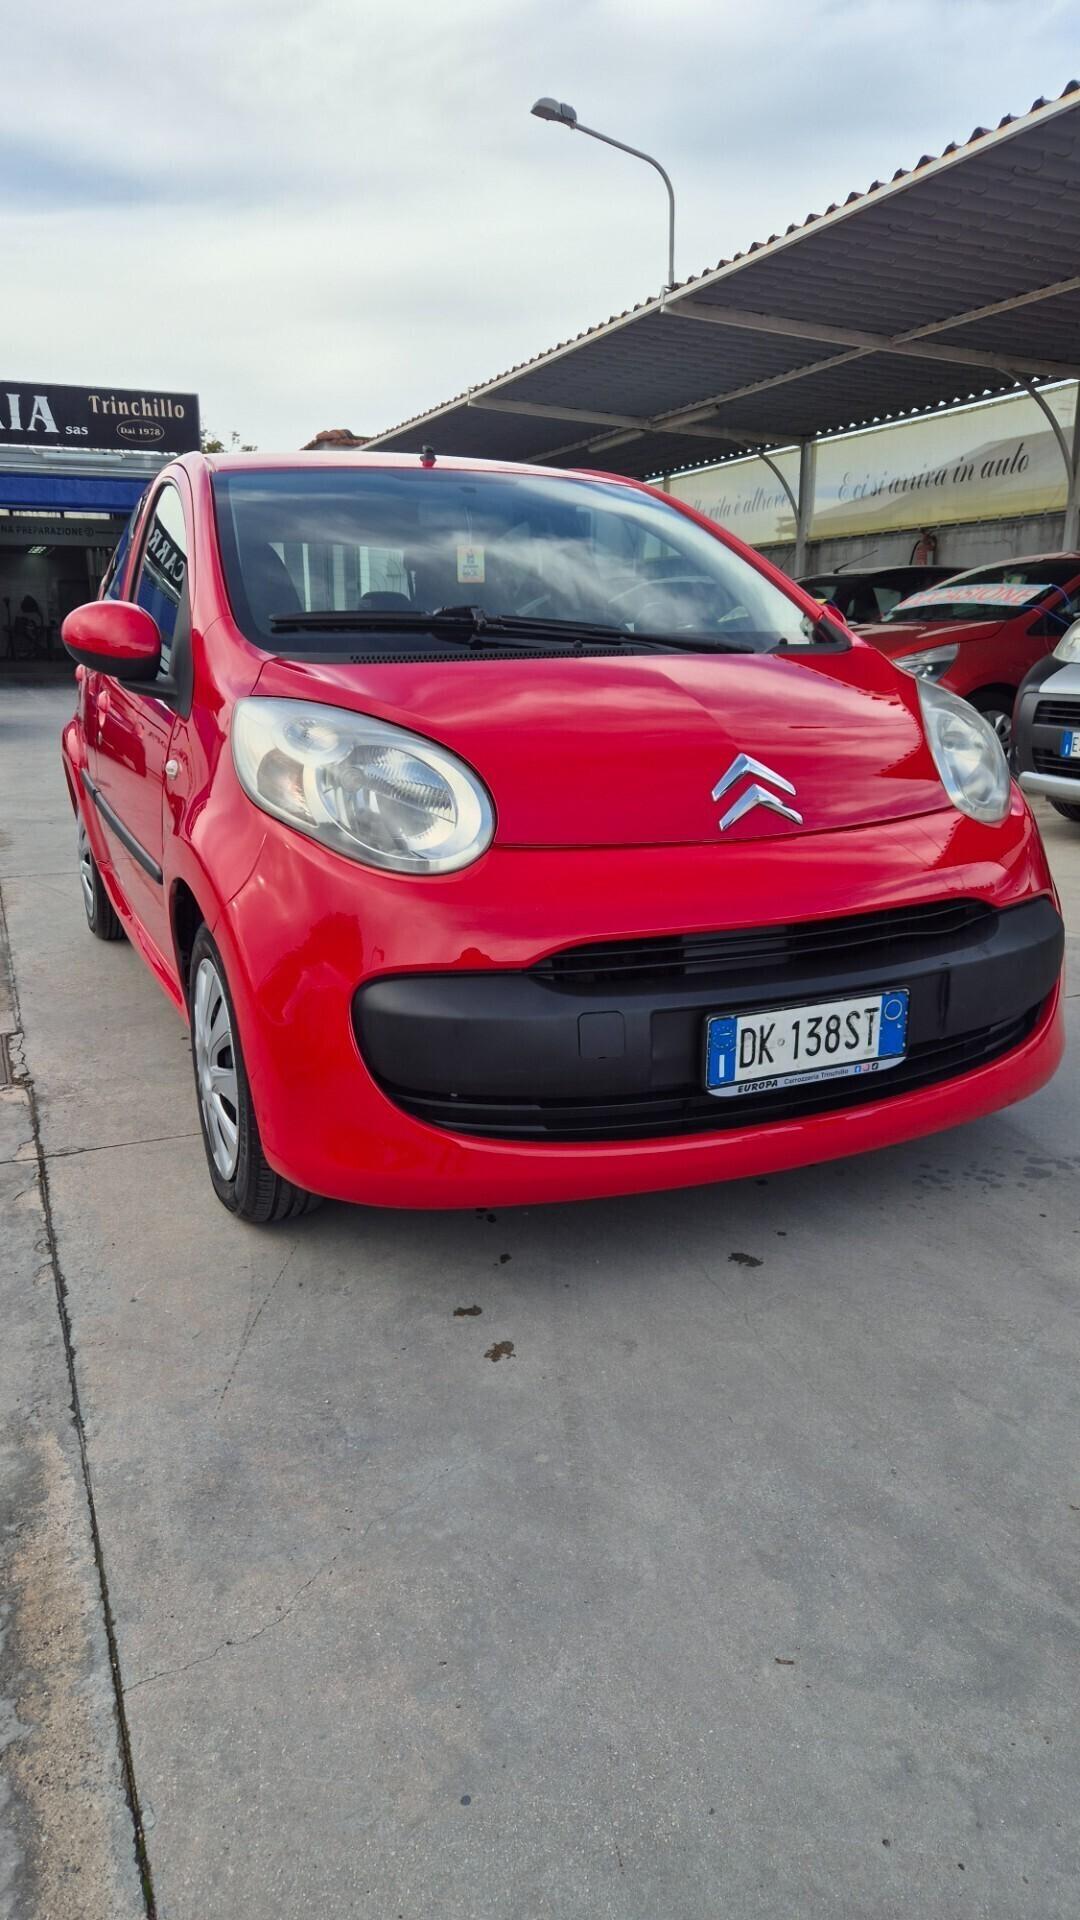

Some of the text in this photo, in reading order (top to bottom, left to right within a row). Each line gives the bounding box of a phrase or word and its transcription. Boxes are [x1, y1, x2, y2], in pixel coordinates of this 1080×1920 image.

[0, 393, 89, 435] IA sas
[88, 394, 185, 418] Trinchillo
[120, 427, 161, 436] Dai 1978
[952, 456, 975, 483] in
[980, 442, 1030, 480] auto
[739, 1022, 776, 1069] DK
[791, 1006, 880, 1060] 138ST
[737, 1079, 778, 1094] EUROPA
